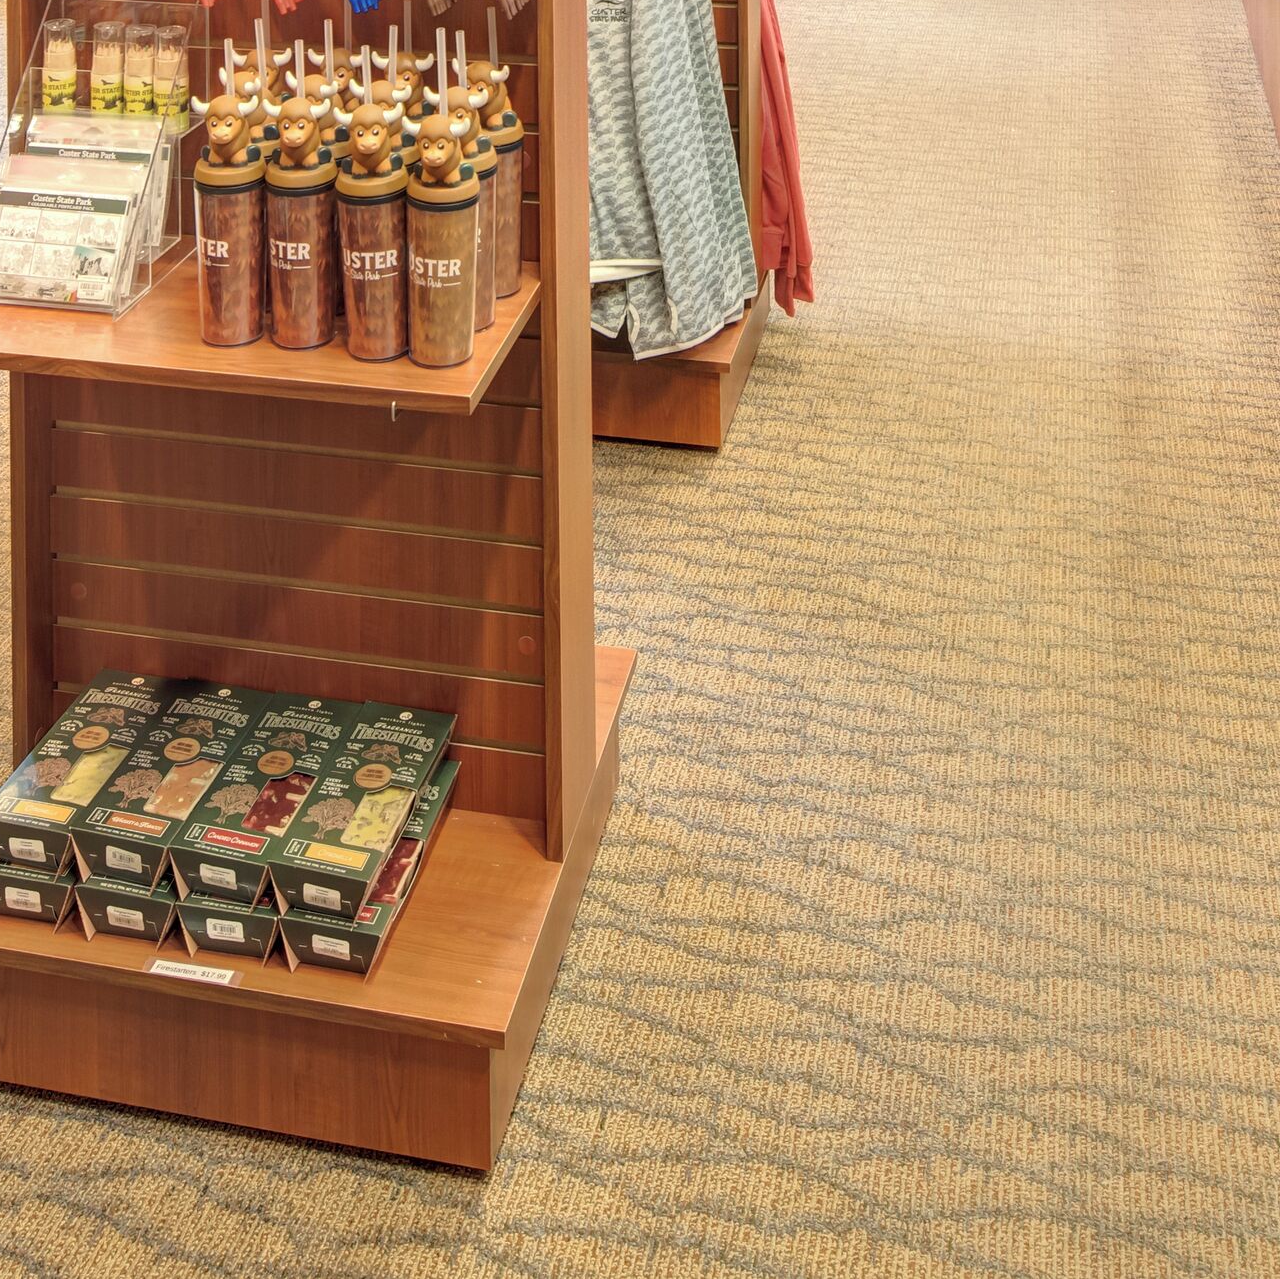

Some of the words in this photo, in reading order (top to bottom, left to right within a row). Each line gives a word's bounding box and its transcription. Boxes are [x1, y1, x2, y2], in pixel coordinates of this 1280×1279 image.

[591, 7, 626, 16] CUSTER
[58, 149, 81, 159] Custer
[81, 150, 98, 159] State
[100, 151, 117, 160] Park
[32, 193, 55, 203] Custer
[56, 195, 75, 204] State
[76, 197, 93, 206] Park
[200, 236, 229, 258] TER
[269, 238, 311, 260] STER
[343, 248, 398, 270] USTER
[409, 253, 462, 277] USTER
[104, 686, 151, 699] FRAGRANCED
[79, 688, 161, 715] FIRESTARTERS
[191, 697, 239, 711] FRAGRANCED
[166, 698, 250, 728] FIRESTARTERS
[282, 710, 331, 723] FRAGRANCED
[258, 711, 342, 740] FIRESTARTERS
[373, 721, 423, 735] FRAGRANCED
[350, 723, 435, 753] FIRESTARTERS
[44, 742, 69, 750] PURCHASE
[134, 753, 160, 761] PURCHASE
[323, 781, 350, 789] PURCHASE
[207, 831, 231, 844] CANDIED
[231, 836, 260, 848] CINNAMON
[155, 963, 197, 976] Firestarters
[200, 970, 227, 980] $17.99
